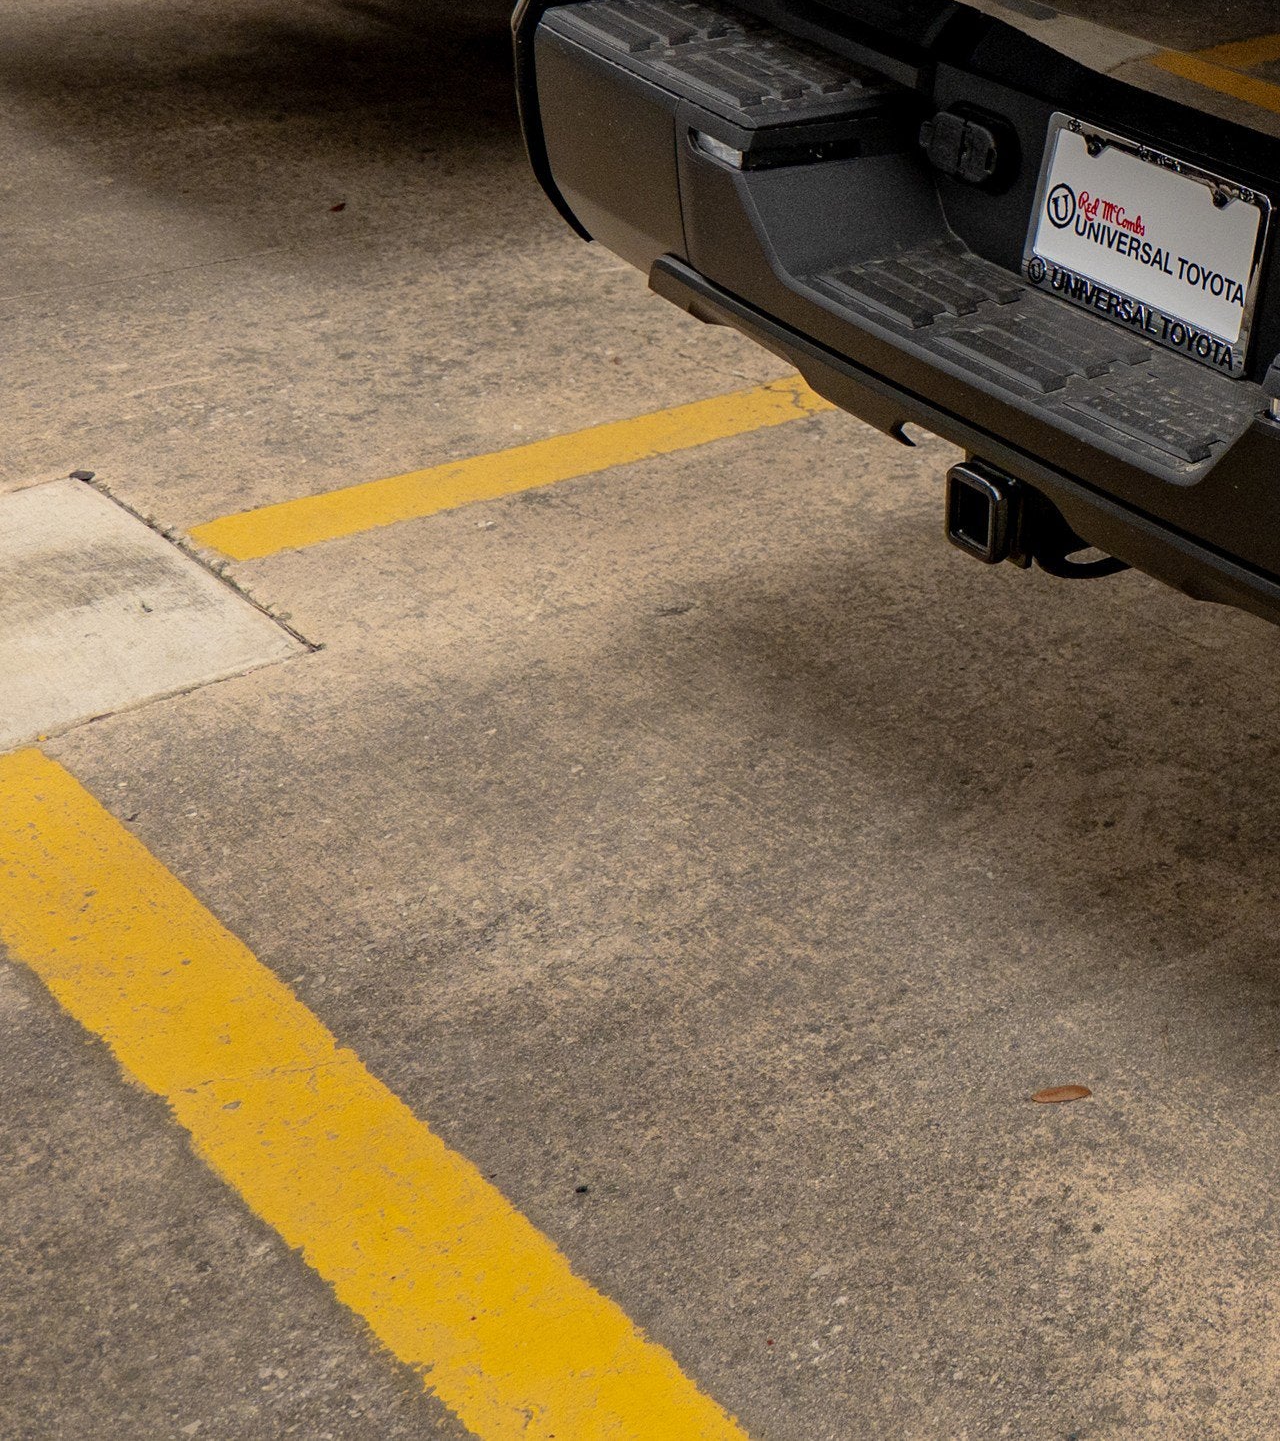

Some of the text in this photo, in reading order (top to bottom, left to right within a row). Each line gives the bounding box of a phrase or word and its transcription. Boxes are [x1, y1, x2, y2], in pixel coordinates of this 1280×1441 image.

[1074, 213, 1245, 308] UNIVERSAL TOYOTA
[1078, 191, 1146, 237] Red McCombs
[1049, 265, 1234, 372] UNIVERSAL TOYOTA
